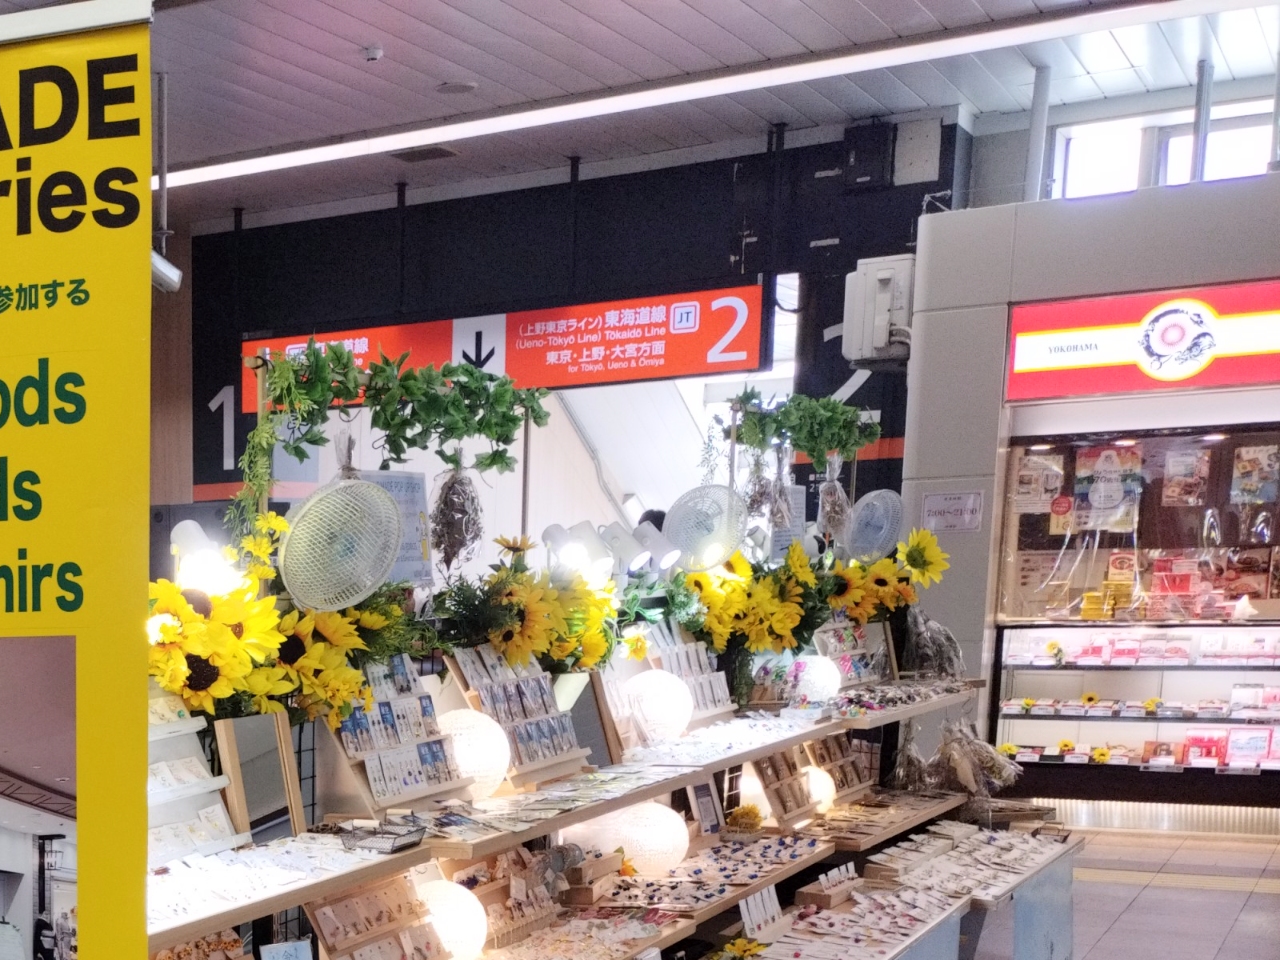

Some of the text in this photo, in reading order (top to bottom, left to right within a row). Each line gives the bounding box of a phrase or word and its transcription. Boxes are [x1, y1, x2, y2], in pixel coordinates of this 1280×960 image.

[605, 305, 667, 328] 東海道線
[677, 311, 693, 324] JT
[577, 331, 602, 346] Line)
[645, 326, 666, 338] Line
[706, 295, 749, 364] 2
[1048, 343, 1099, 354] YOKOHAMA
[567, 365, 579, 374] for
[608, 360, 628, 370] Ueno
[630, 360, 637, 368] &
[207, 384, 235, 470] 1
